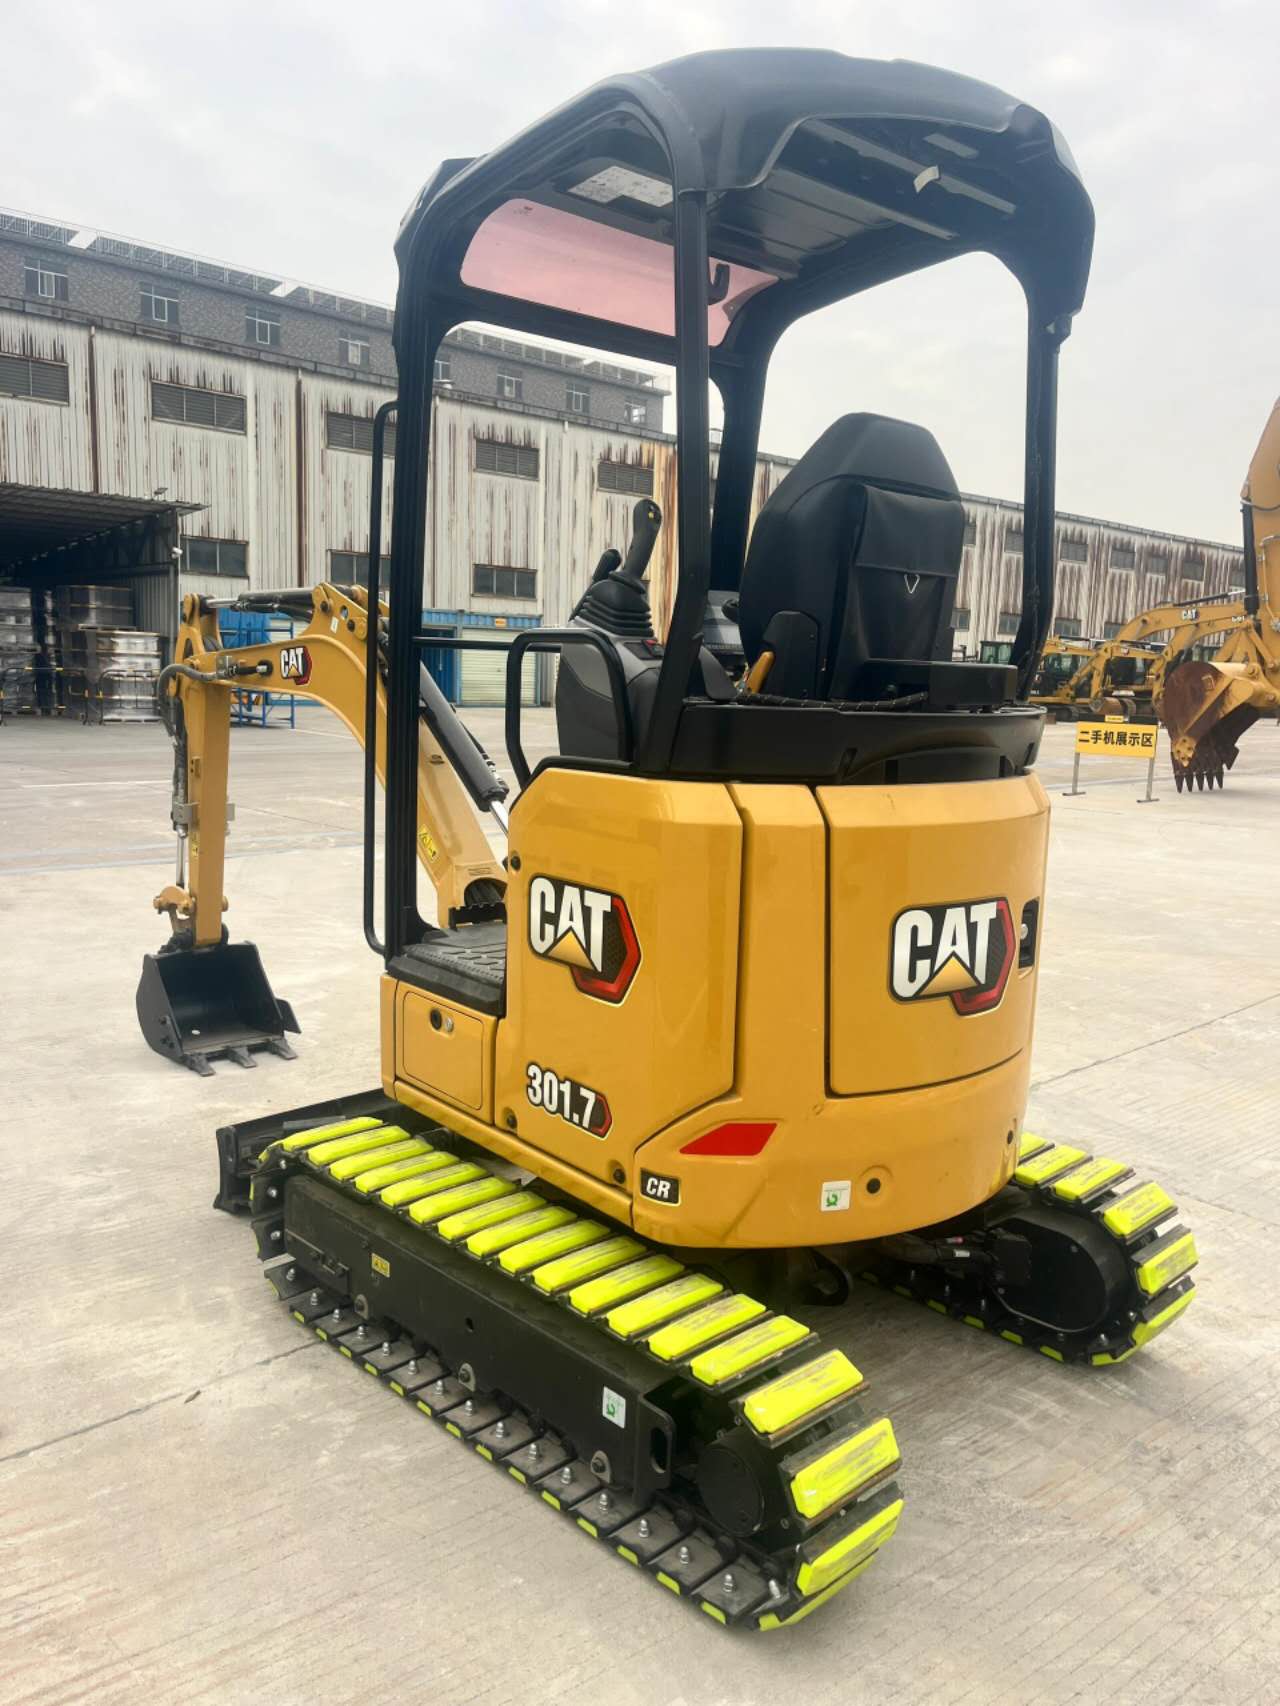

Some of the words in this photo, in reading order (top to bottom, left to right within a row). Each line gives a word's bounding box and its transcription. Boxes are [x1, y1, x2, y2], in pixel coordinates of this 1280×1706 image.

[281, 647, 304, 678] CAT
[1078, 730, 1154, 748] 二手机展示区
[530, 877, 612, 972] CAT
[893, 901, 998, 998] CAT
[527, 1064, 596, 1129] 301.7
[646, 1177, 671, 1199] CR
